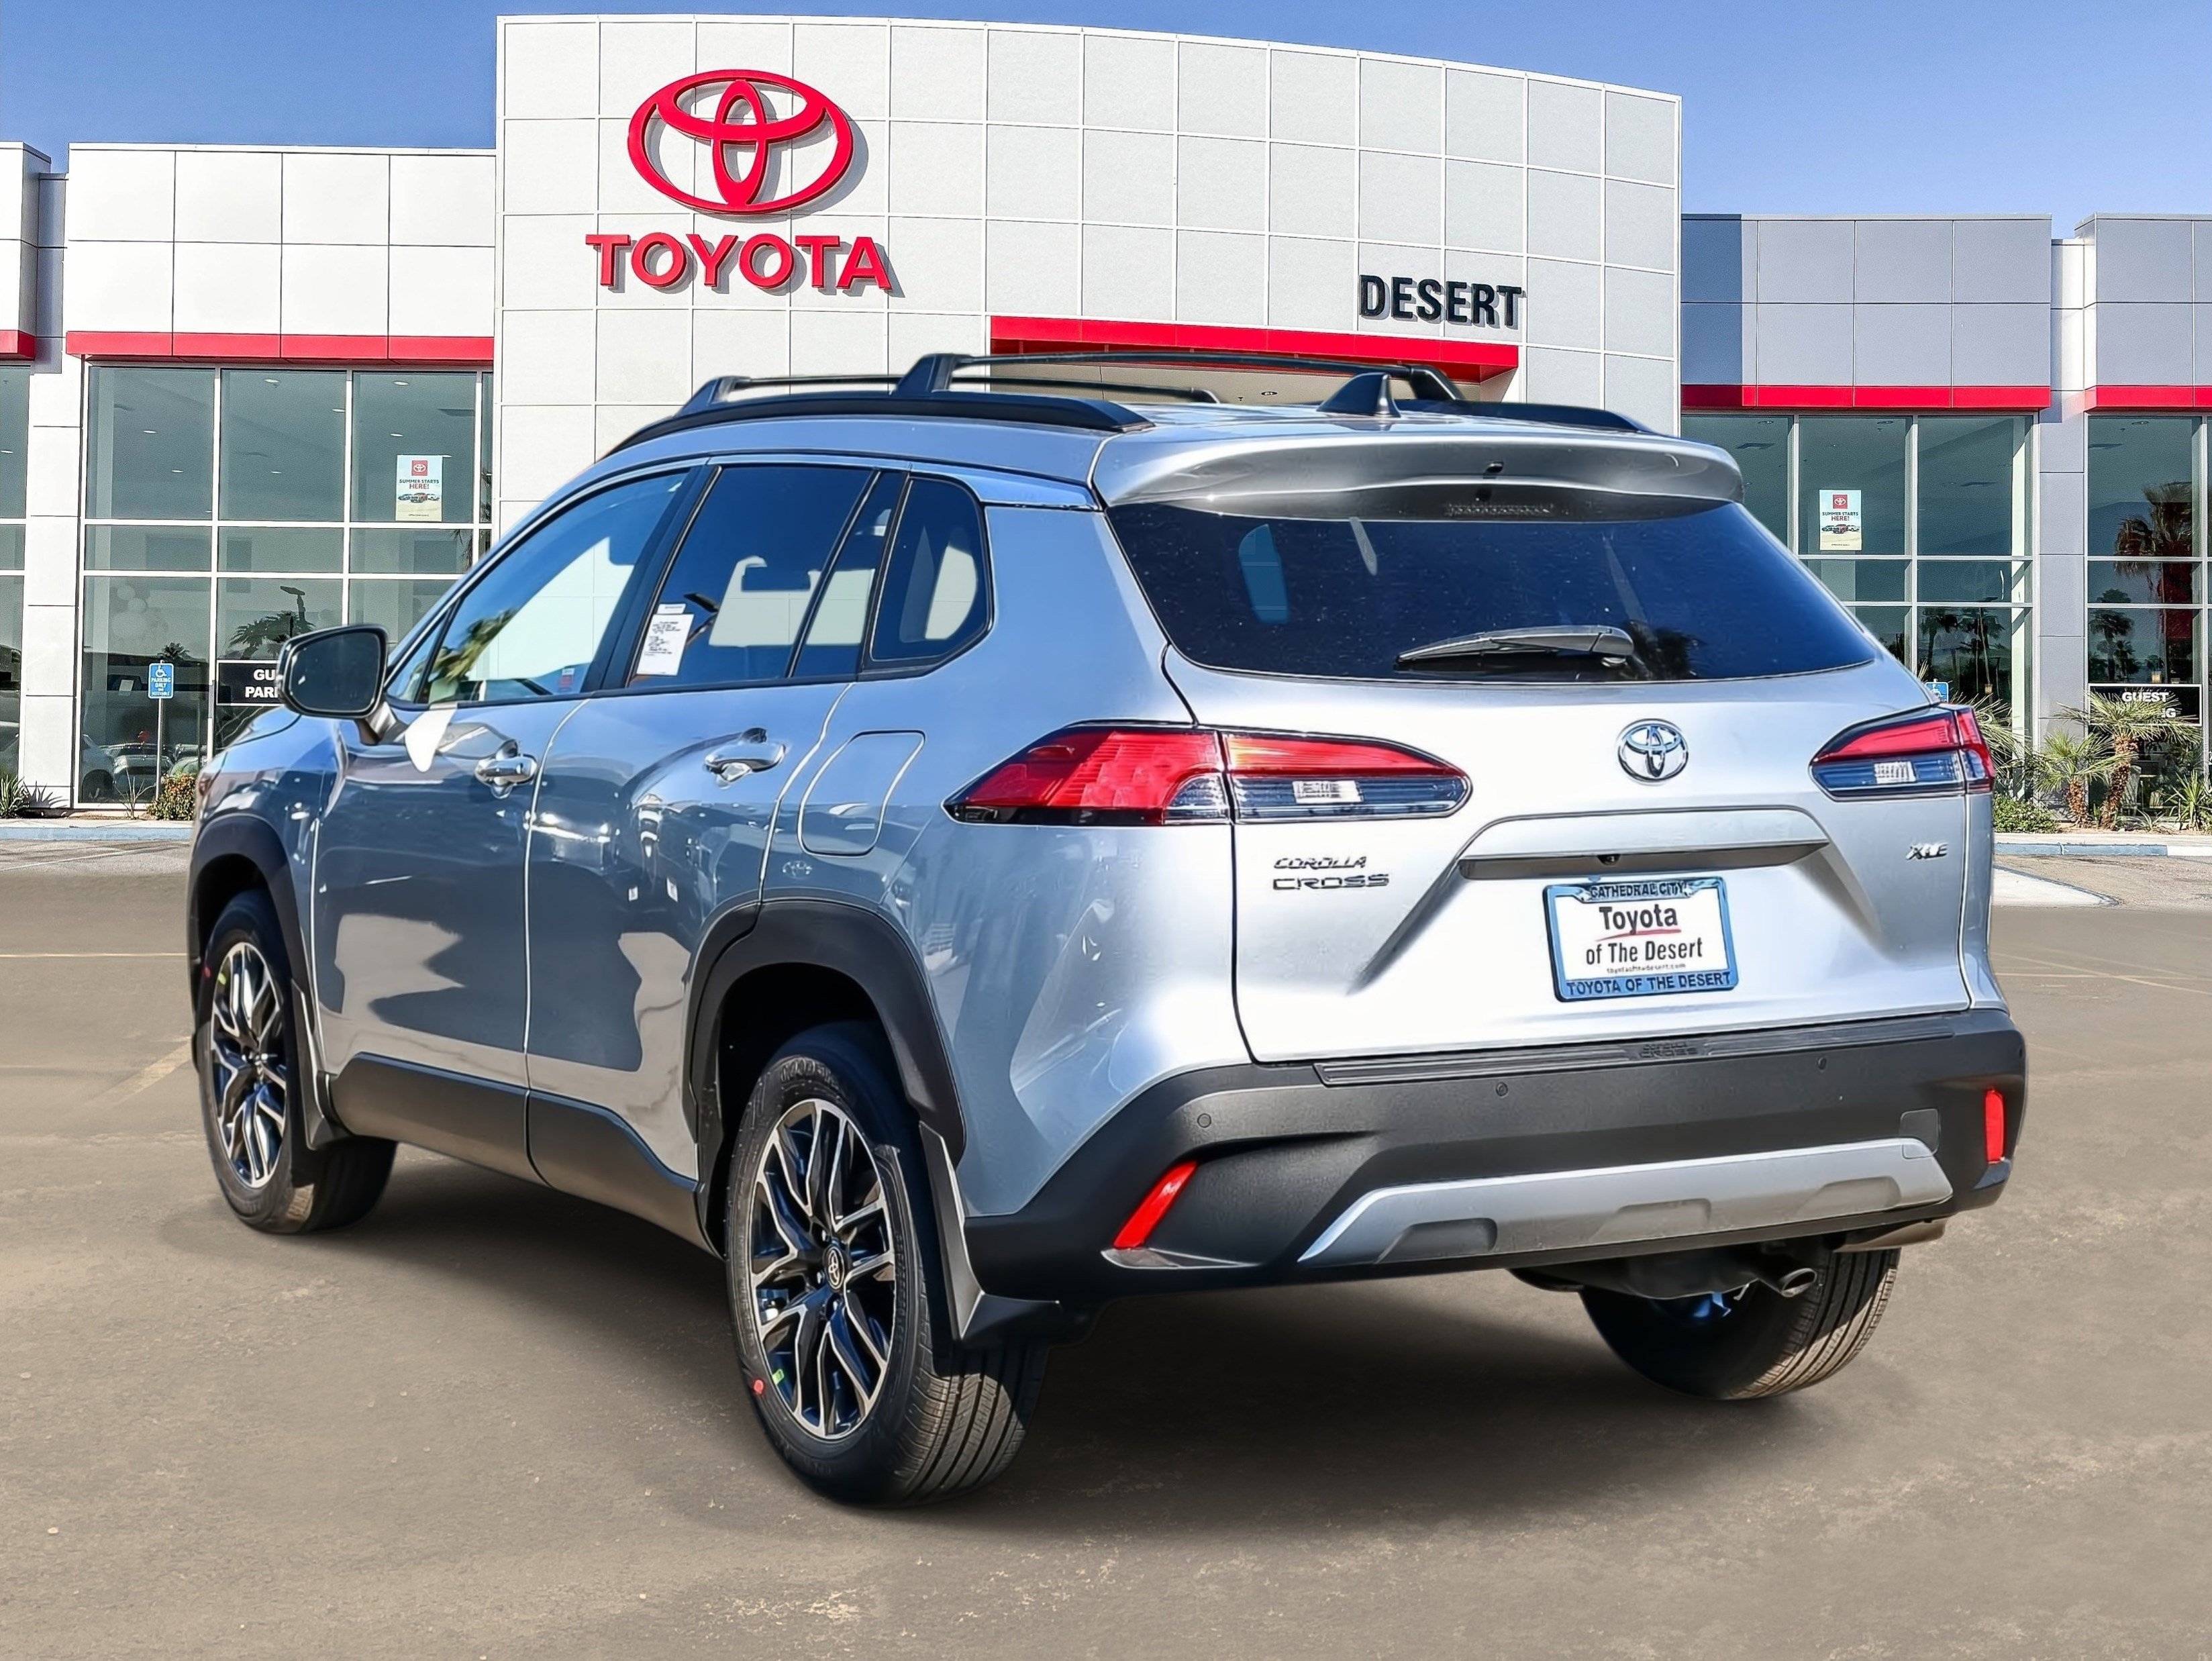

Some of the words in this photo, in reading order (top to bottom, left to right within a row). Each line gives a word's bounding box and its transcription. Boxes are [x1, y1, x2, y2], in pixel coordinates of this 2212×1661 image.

[586, 232, 892, 289] TOYOTA
[1359, 274, 1521, 326] DESERT
[2122, 691, 2169, 703] GUEST
[1906, 844, 1948, 860] XLE
[1274, 856, 1366, 870] COROLLA
[1273, 874, 1389, 890] CROSS
[1590, 883, 1658, 899] CATHEDRAL
[1658, 882, 1686, 896] CITY
[1599, 903, 1678, 935] Toyota
[1586, 944, 1603, 965] of
[1608, 942, 1638, 963] The
[1645, 938, 1703, 961] Desert
[1566, 979, 1620, 996] TOYOTA
[1625, 978, 1642, 992] OF
[1647, 974, 1674, 991] THE
[1679, 971, 1731, 987] DESERT
